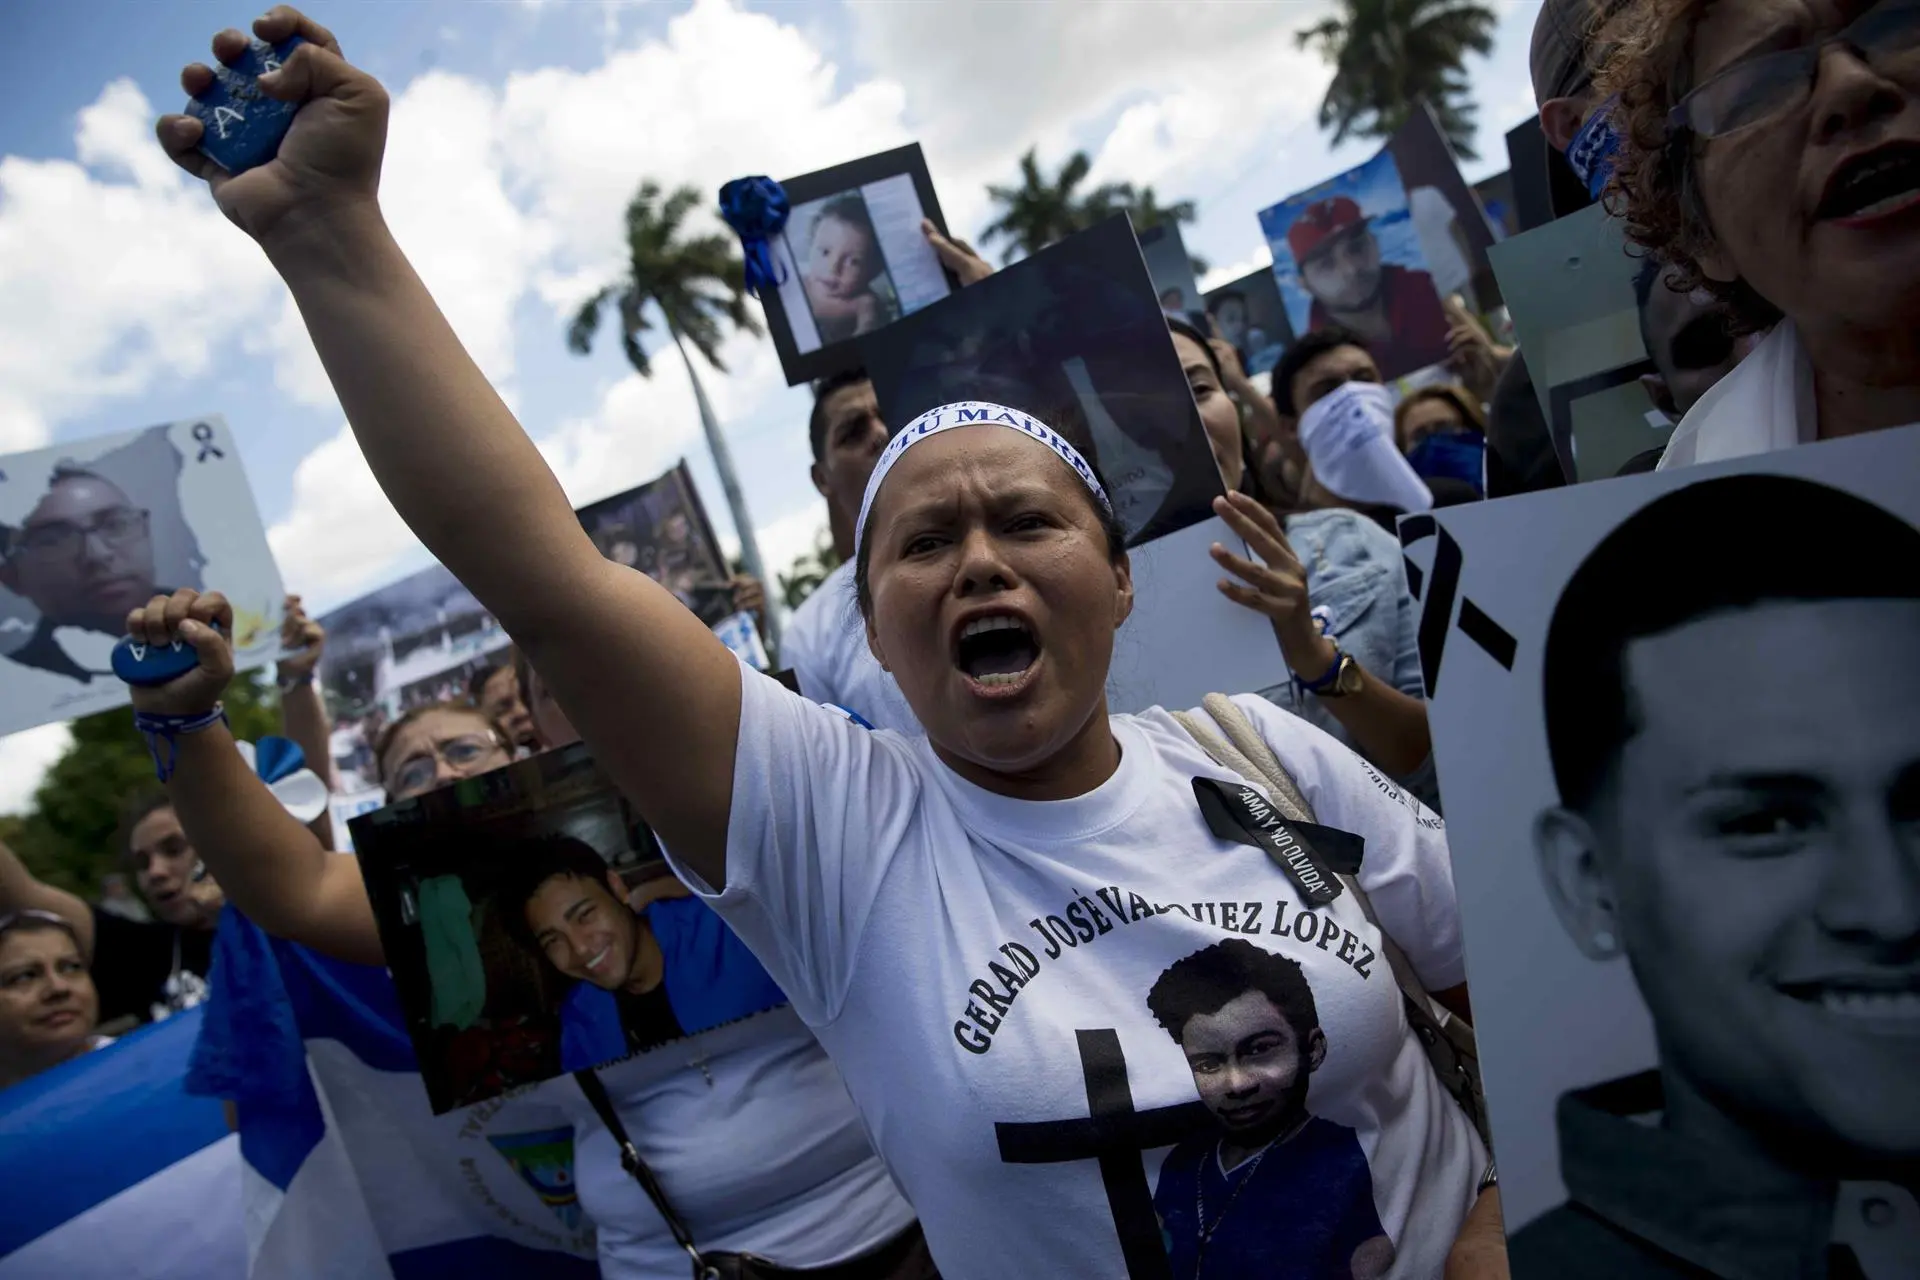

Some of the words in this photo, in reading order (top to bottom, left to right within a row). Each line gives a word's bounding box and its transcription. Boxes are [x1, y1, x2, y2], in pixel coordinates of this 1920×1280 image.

[214, 106, 245, 139] A
[954, 408, 1090, 480] MADRE
[1260, 815, 1280, 829] Y
[1270, 826, 1294, 847] NO
[1270, 900, 1376, 980] LOPEZ
